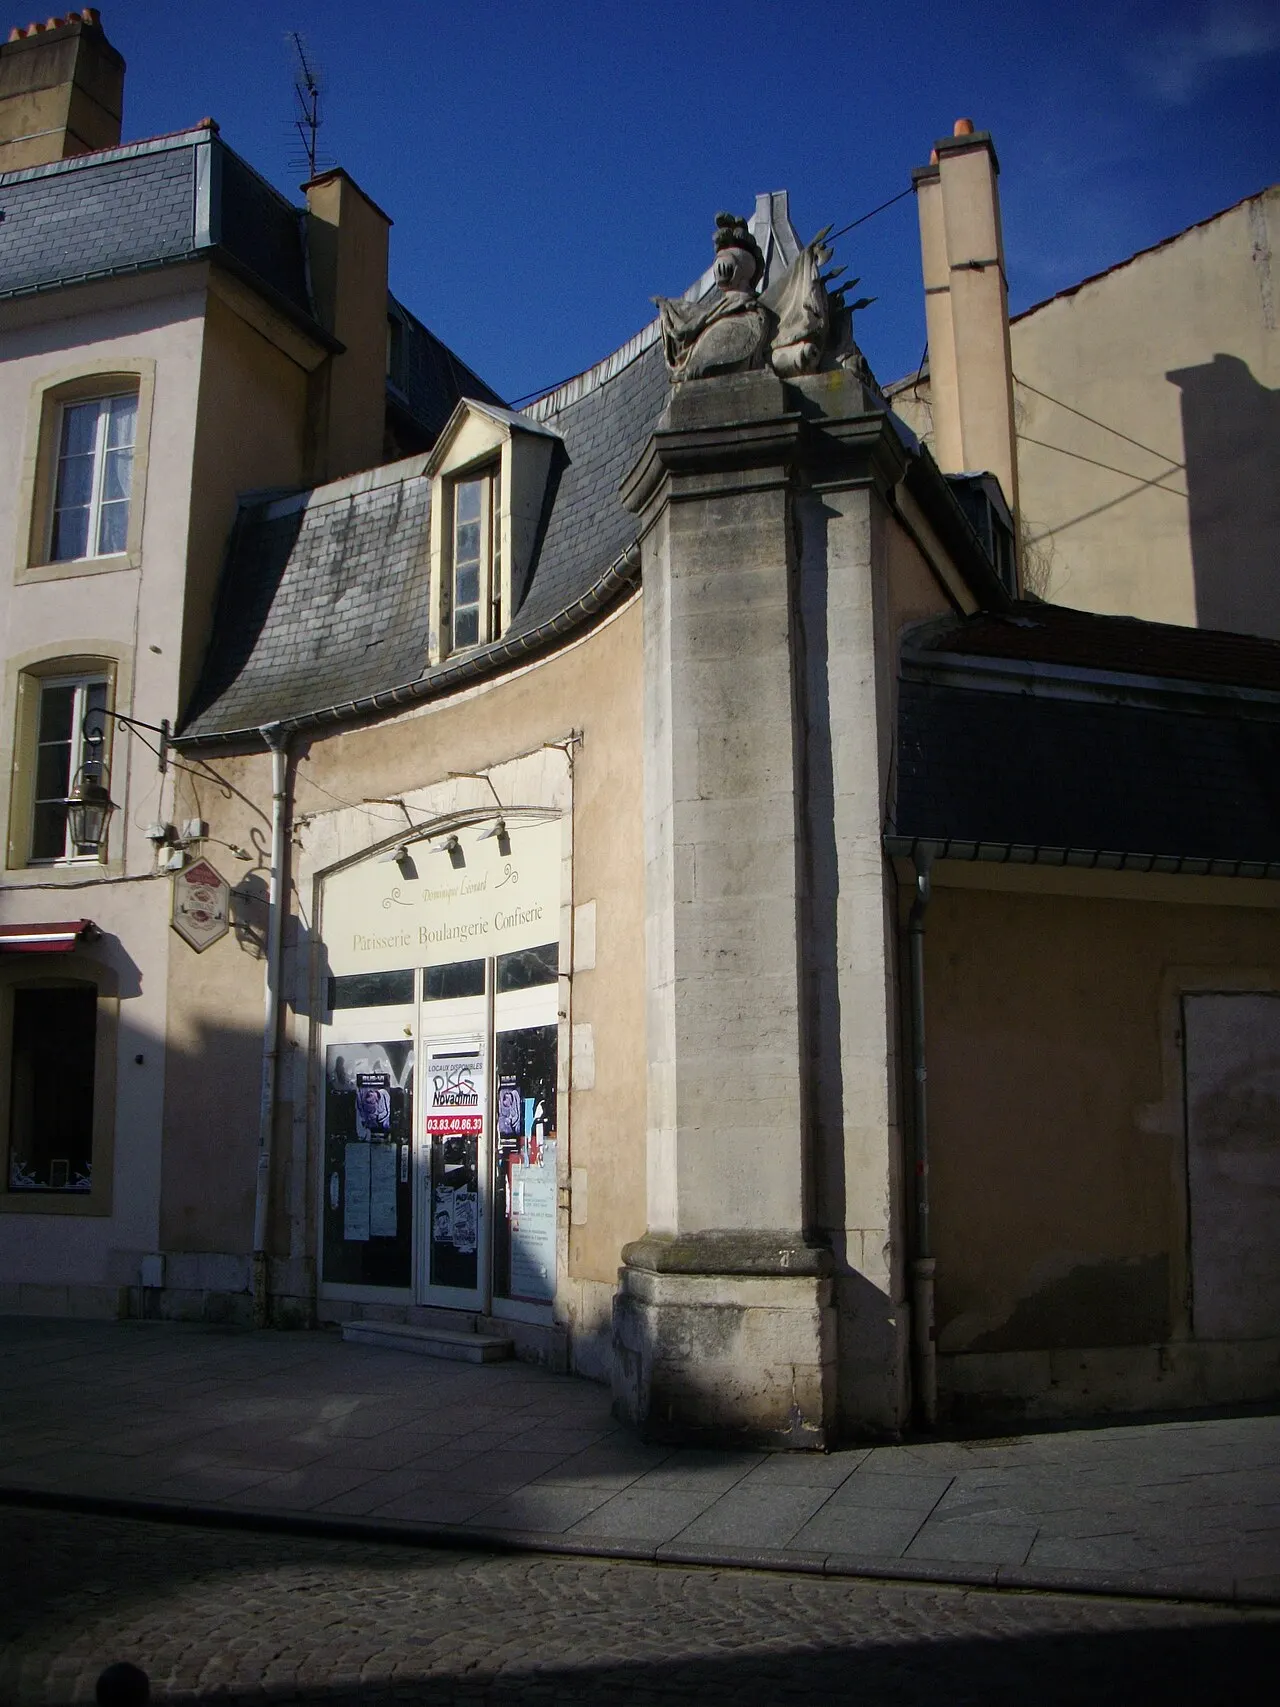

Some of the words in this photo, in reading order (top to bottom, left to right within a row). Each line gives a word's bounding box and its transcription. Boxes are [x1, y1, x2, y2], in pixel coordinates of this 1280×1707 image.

[423, 883, 459, 904] Dominique
[418, 917, 489, 945] Boulangerie
[494, 902, 543, 931] Confiserie
[428, 1064, 450, 1073] LOCAUX
[450, 1062, 483, 1072] DISPONIBLES
[433, 1091, 479, 1106] Novadimm
